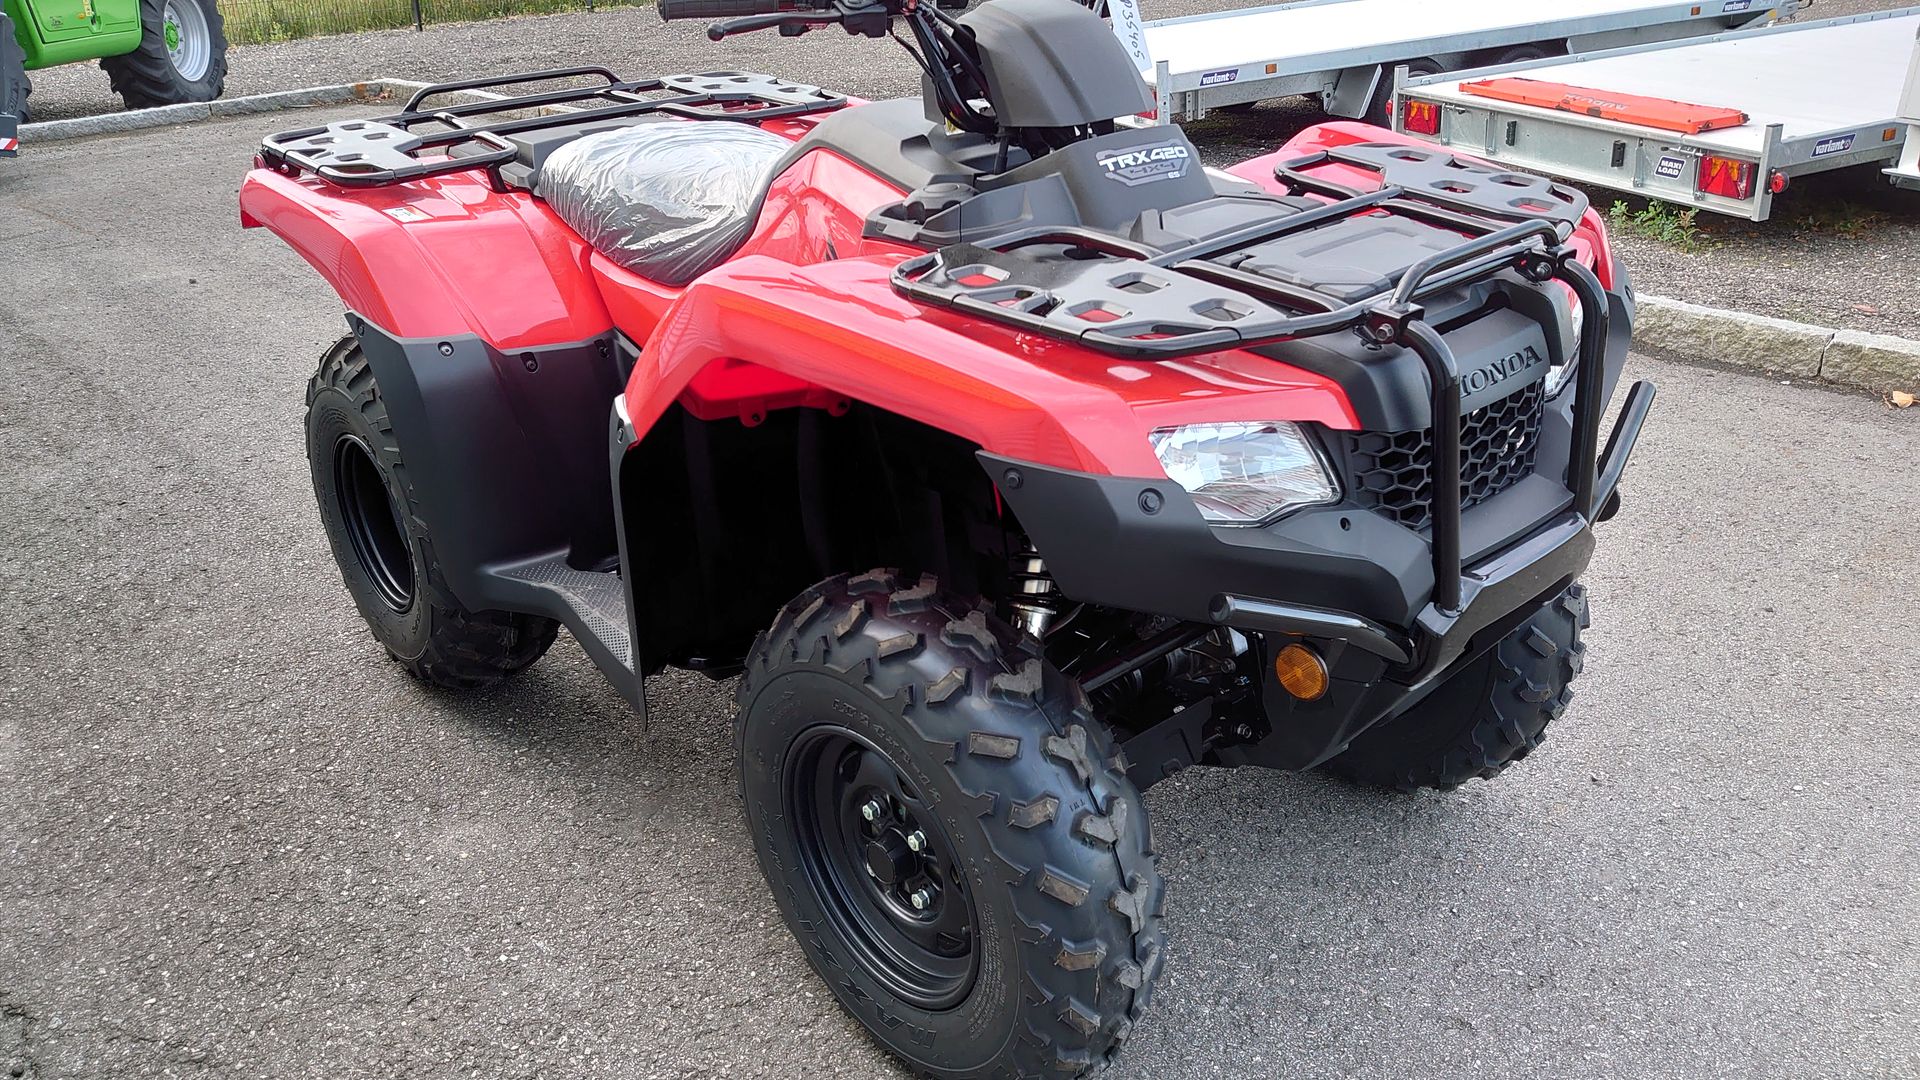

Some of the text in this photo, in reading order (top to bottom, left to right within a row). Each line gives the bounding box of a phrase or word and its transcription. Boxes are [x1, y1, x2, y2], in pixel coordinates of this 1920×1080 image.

[1202, 72, 1230, 85] variant
[1815, 139, 1846, 155] variant
[1099, 146, 1188, 171] TRX420
[1661, 160, 1682, 170] MAXI
[1657, 167, 1679, 176] LOAD
